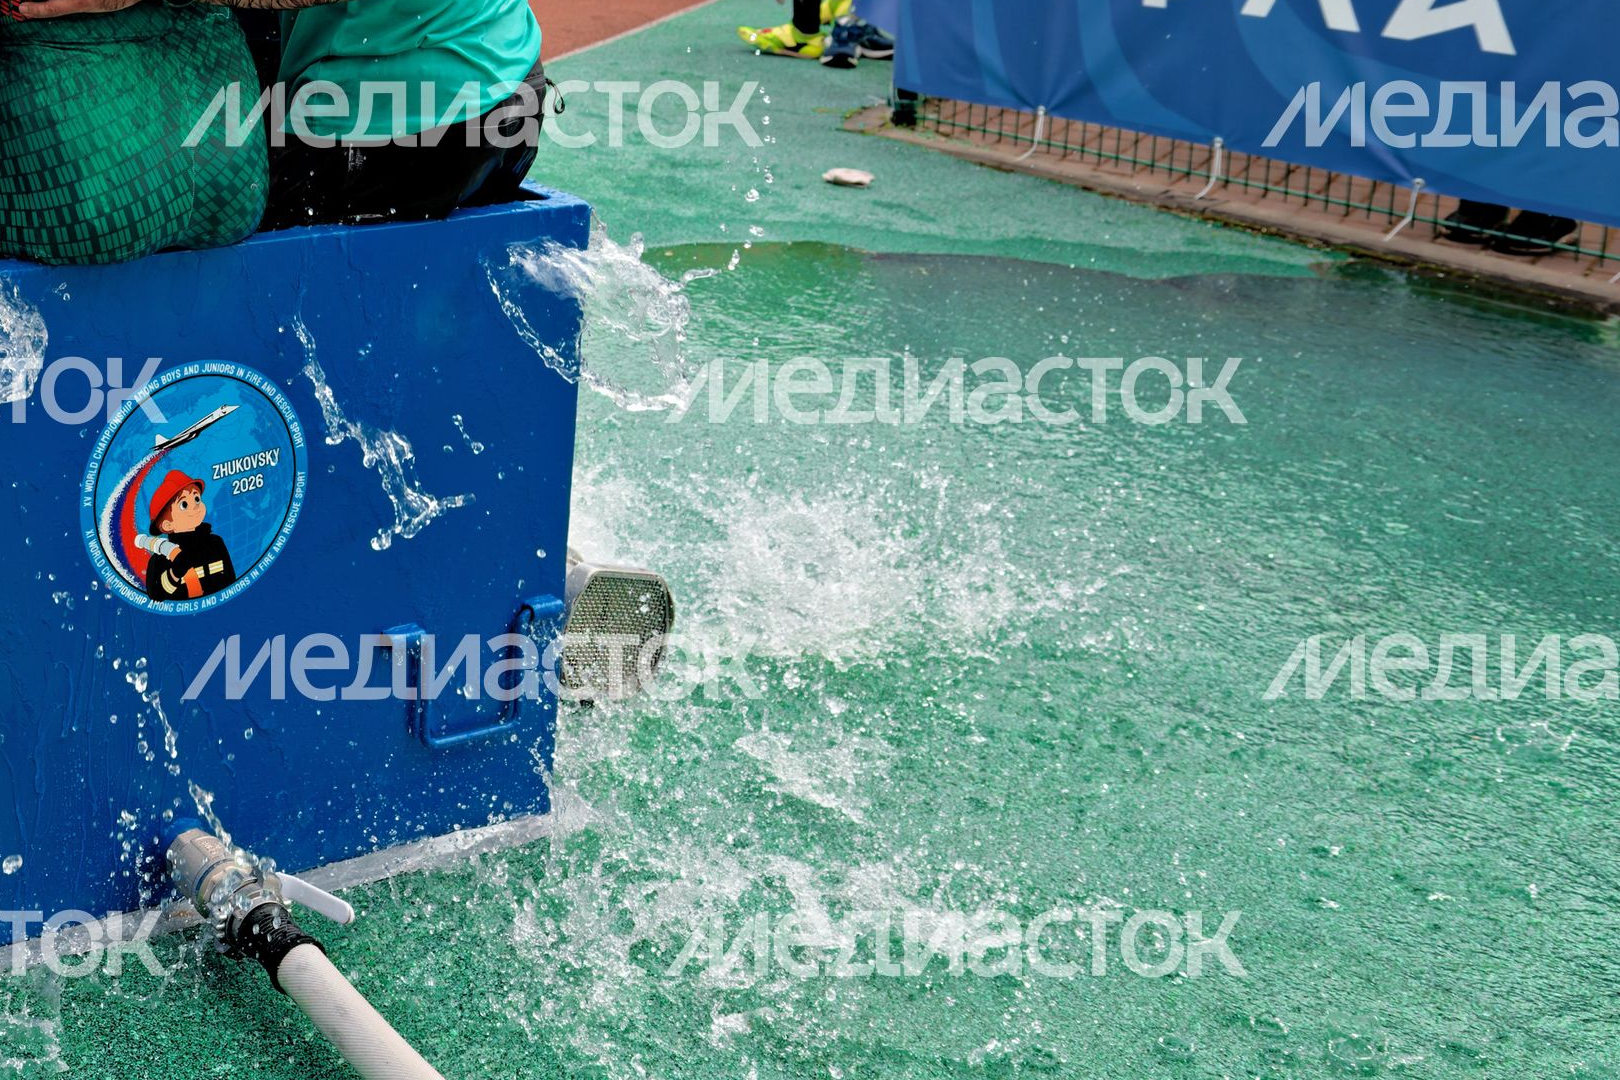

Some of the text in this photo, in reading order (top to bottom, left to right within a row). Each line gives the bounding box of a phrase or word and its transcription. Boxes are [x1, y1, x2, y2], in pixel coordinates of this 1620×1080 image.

[83, 363, 304, 507] XV WORLD CHAMPIONSHIP AMONG BOYS AND JUNIORS IN FIRE AND RESCUE SPORT
[212, 448, 281, 480] ZHUKOVSKY
[232, 474, 264, 496] 2026
[89, 541, 104, 569] WORLD
[101, 567, 147, 607] CHAMPIONSHIP
[147, 598, 174, 612] AMONG
[176, 602, 198, 612] GIRLS
[201, 597, 217, 609] AND
[220, 577, 251, 603] JUNIORS
[251, 569, 259, 579] IN
[258, 554, 275, 575] FIRE
[273, 535, 286, 555] AND
[283, 502, 301, 535] RESCUE
[295, 471, 306, 499] SPORT
